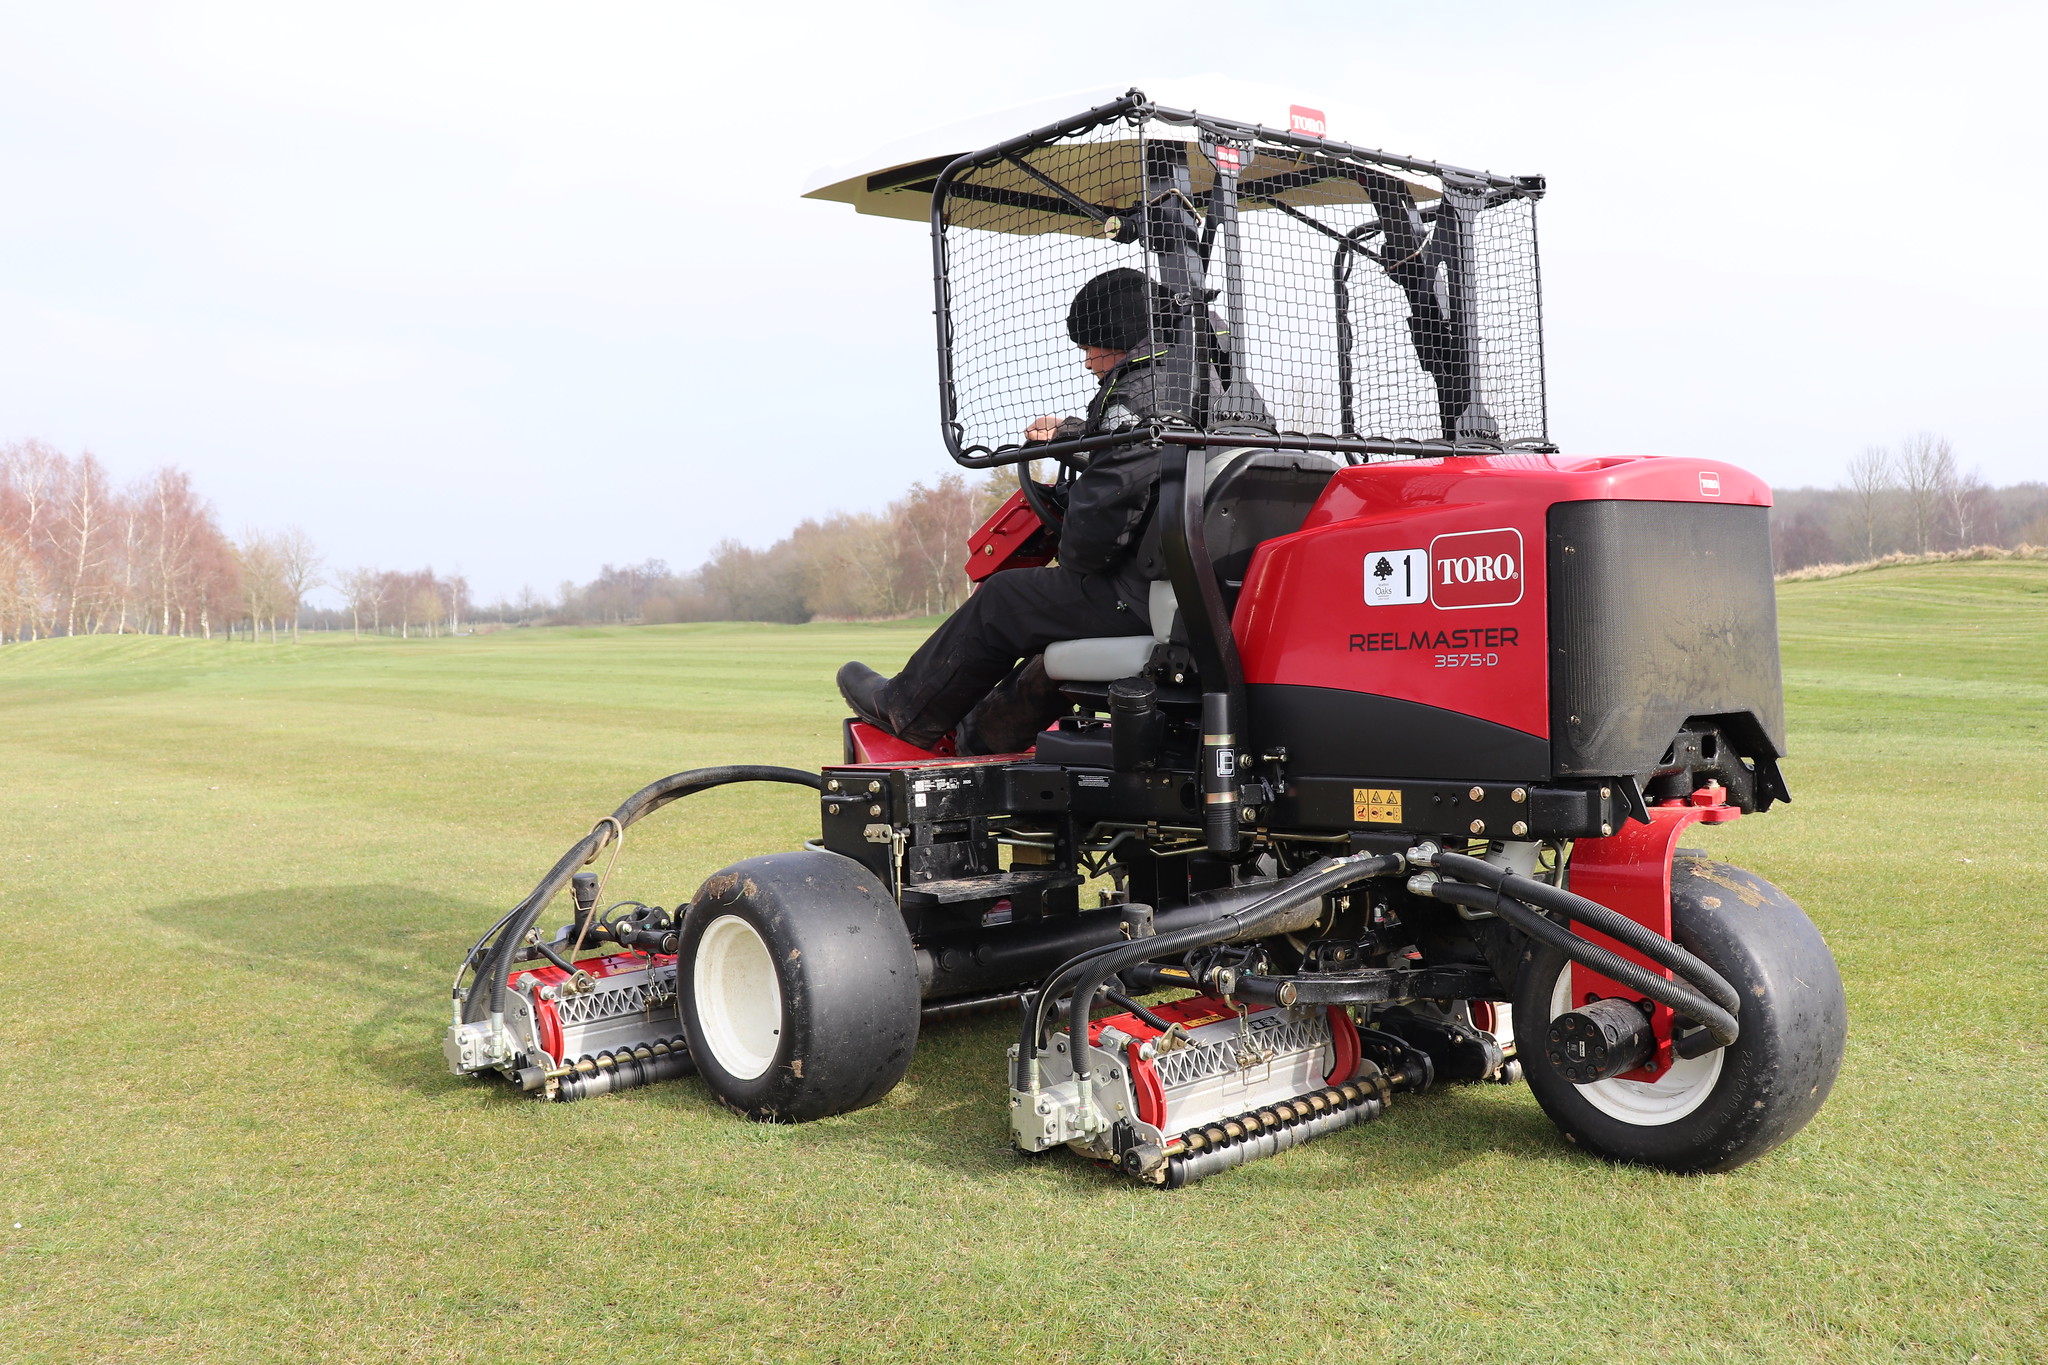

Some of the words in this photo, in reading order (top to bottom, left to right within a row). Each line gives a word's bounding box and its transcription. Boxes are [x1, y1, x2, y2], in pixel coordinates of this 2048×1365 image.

[1291, 114, 1325, 134] TORO
[1403, 554, 1411, 597] 1
[1375, 586, 1392, 596] Oaks
[1349, 627, 1519, 652] REELMASTER
